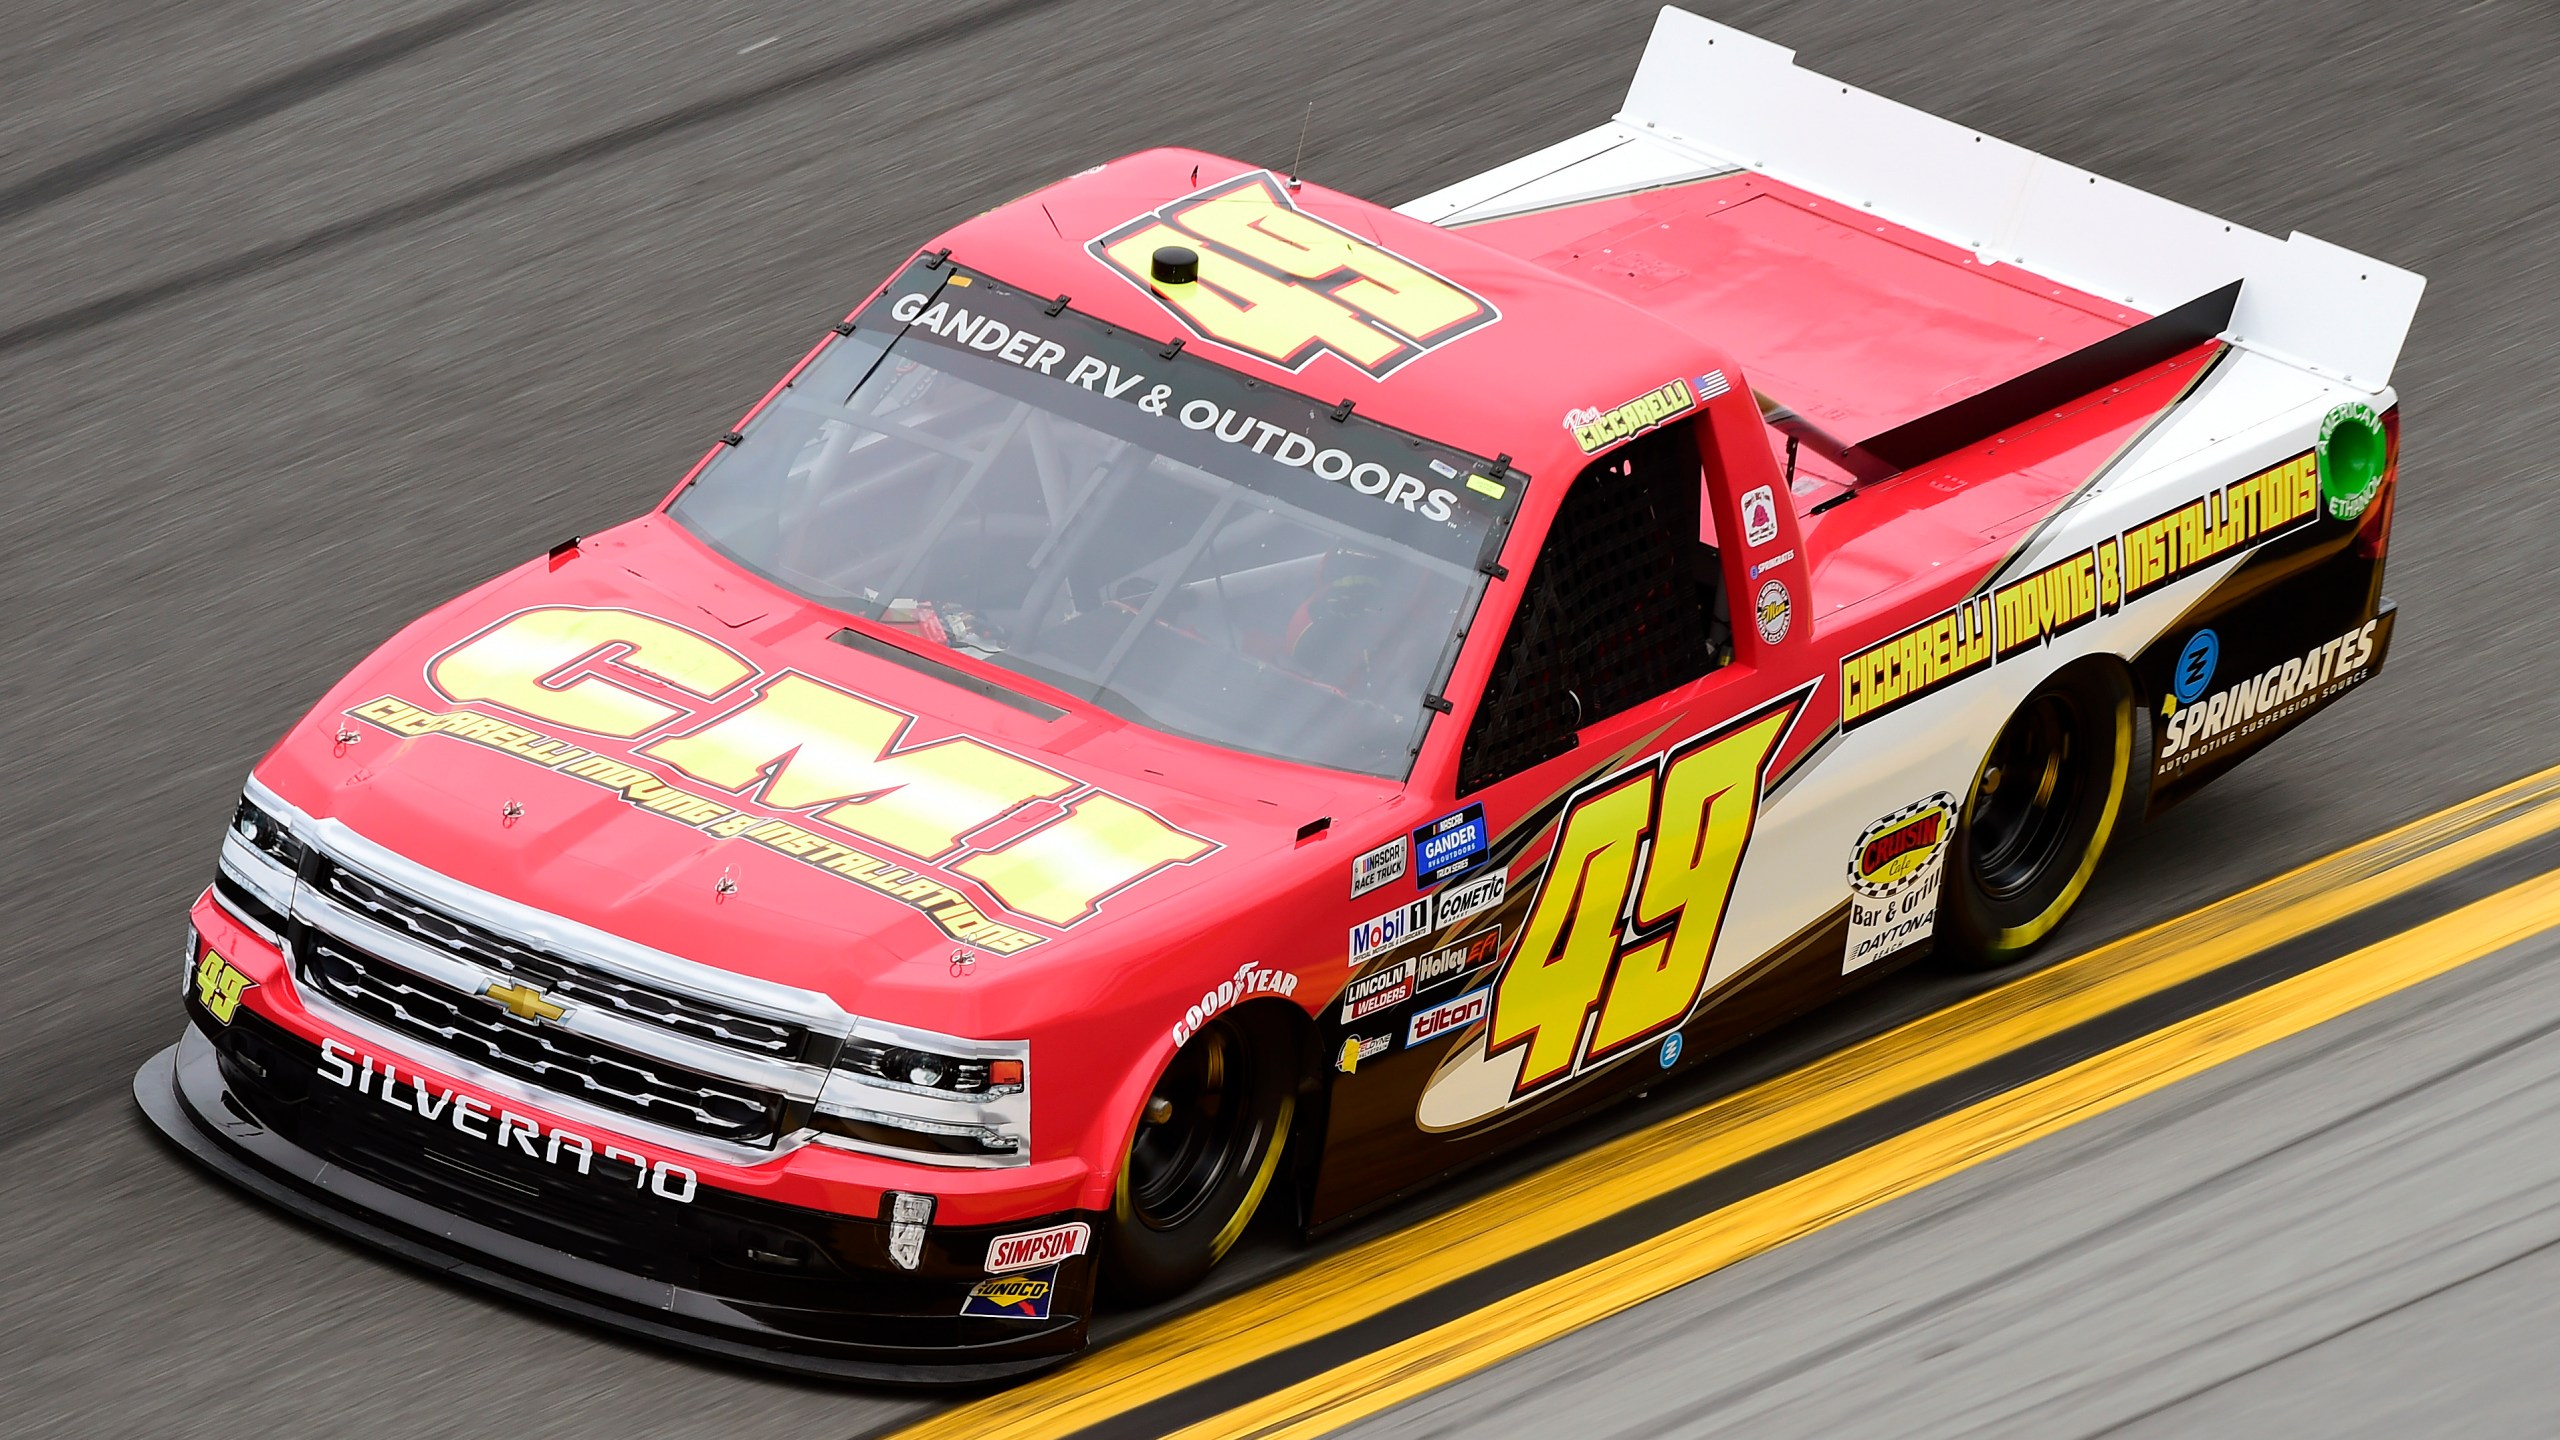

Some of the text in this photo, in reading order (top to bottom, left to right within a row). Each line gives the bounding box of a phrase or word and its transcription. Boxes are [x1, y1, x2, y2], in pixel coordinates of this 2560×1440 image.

[1086, 171, 1501, 381] 49
[892, 293, 1064, 374] GANDER
[1069, 351, 1144, 400] RV
[1138, 384, 1173, 417] &
[1179, 398, 1458, 521] OUTDOORS
[1575, 379, 1693, 453] CICCARELLI
[2318, 402, 2382, 456] AMERICAN
[1843, 452, 2317, 730] CICCARELLI MOVING & INSTALLATIONS
[2161, 619, 2377, 758] SPRINGRATES
[2158, 668, 2368, 776] AUTOMOTIVE SUSPENSION SOURCE
[342, 695, 592, 770] CICCARELLI
[558, 753, 735, 827] MOVING
[740, 818, 1050, 957] INSTALLATIONS
[1425, 825, 1476, 858] GANDER
[1354, 861, 1402, 891] RACE TRUCK
[1369, 844, 1400, 871] NASCAR
[1889, 855, 1911, 876] Cafe
[1441, 876, 1504, 920] COMETIC
[1487, 675, 1821, 1107] 49
[1852, 867, 1941, 927] Bar & Grill
[1353, 908, 1405, 956] Mobil
[1420, 931, 1498, 983] Holley EFI
[1857, 909, 1935, 957] DAYTONA
[196, 947, 261, 1026] 49
[1172, 961, 1298, 1048] GOODYEAR
[1349, 966, 1404, 1003] LINCOLN
[1358, 985, 1406, 1016] WELDERS
[1414, 996, 1484, 1039] tilton
[994, 1230, 1079, 1267] SIMPSON
